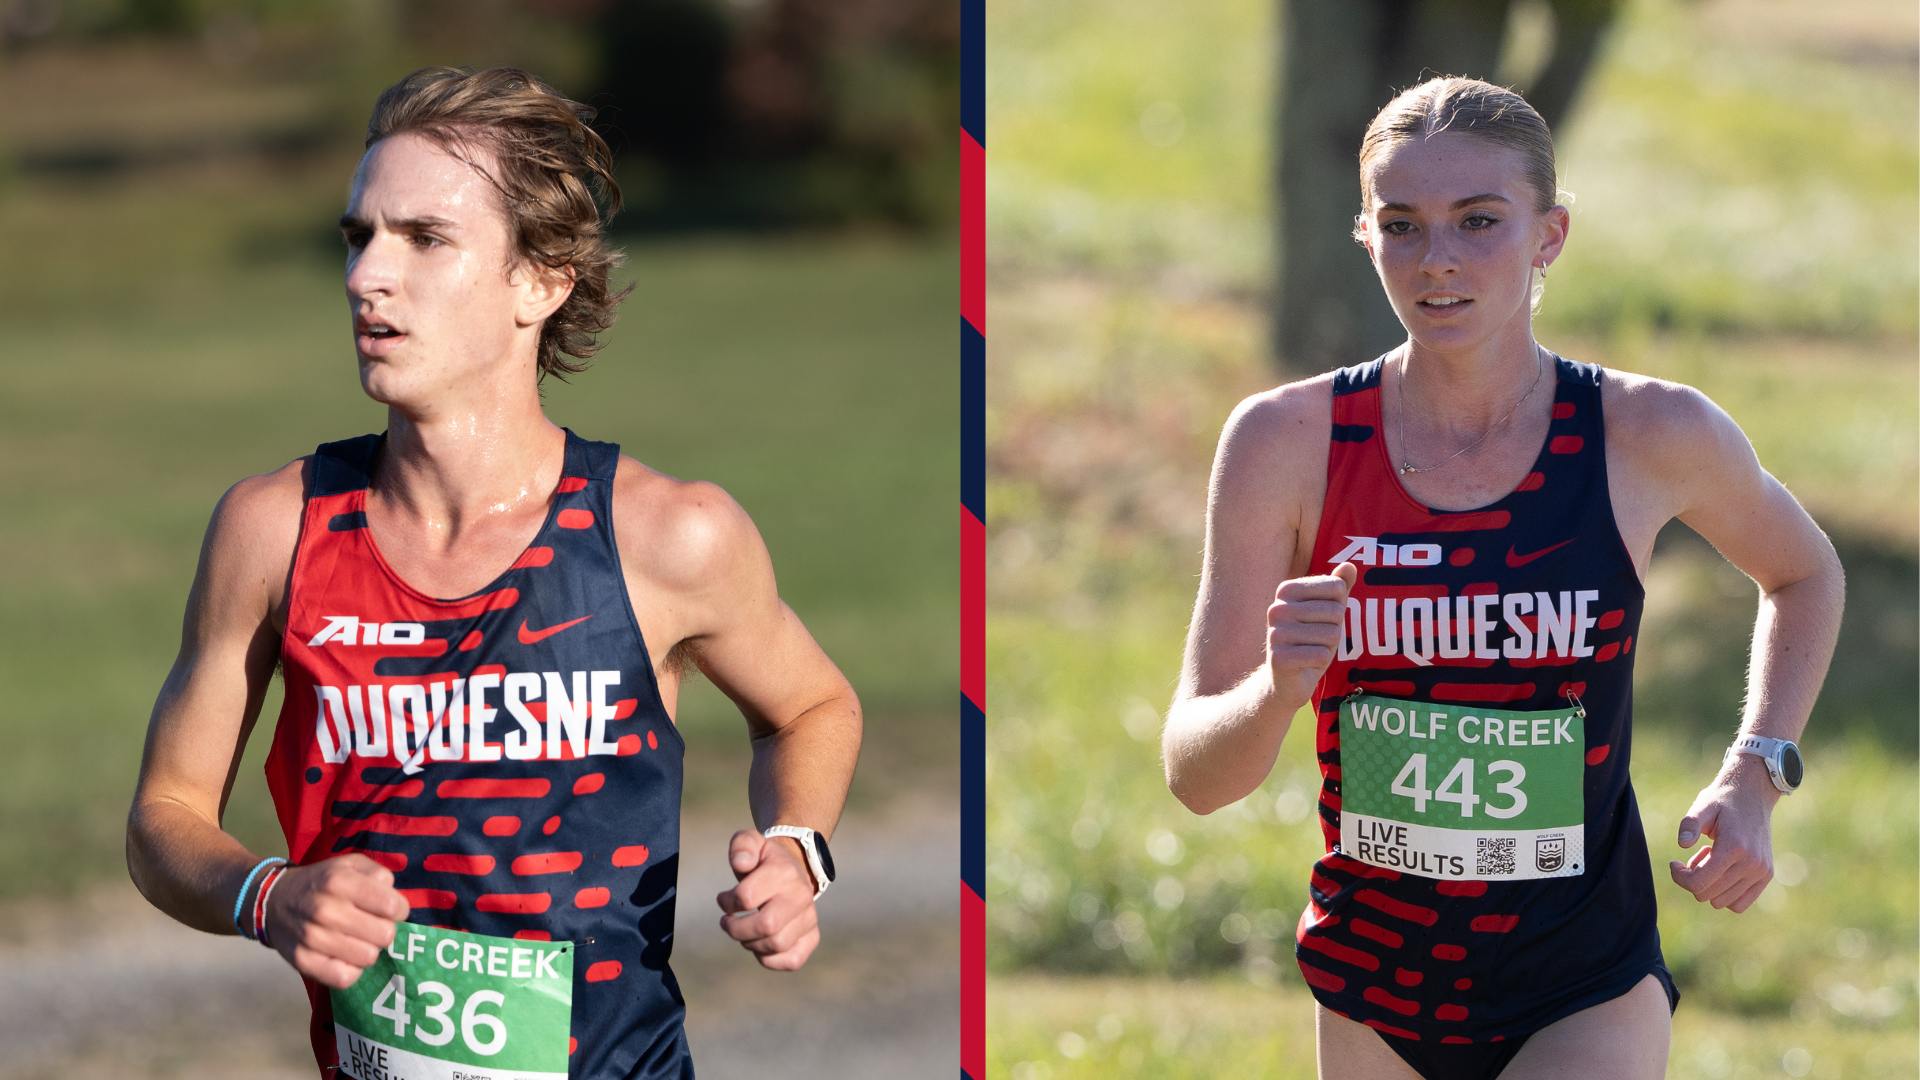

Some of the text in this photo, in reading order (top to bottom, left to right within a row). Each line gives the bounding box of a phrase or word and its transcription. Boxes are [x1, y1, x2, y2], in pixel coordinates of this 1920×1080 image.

[1328, 535, 1442, 566] A10
[307, 616, 425, 647] A10
[1337, 589, 1598, 667] DUQUESNE
[313, 670, 621, 775] DUQUESNE
[1351, 702, 1575, 746] WOLF CREEK
[1391, 753, 1528, 819] 443
[1358, 820, 1408, 846] LIVE
[1358, 841, 1465, 876] RESULTS
[388, 932, 560, 979] LF CREEK
[372, 974, 507, 1056] 436
[347, 1034, 389, 1070] LIVE
